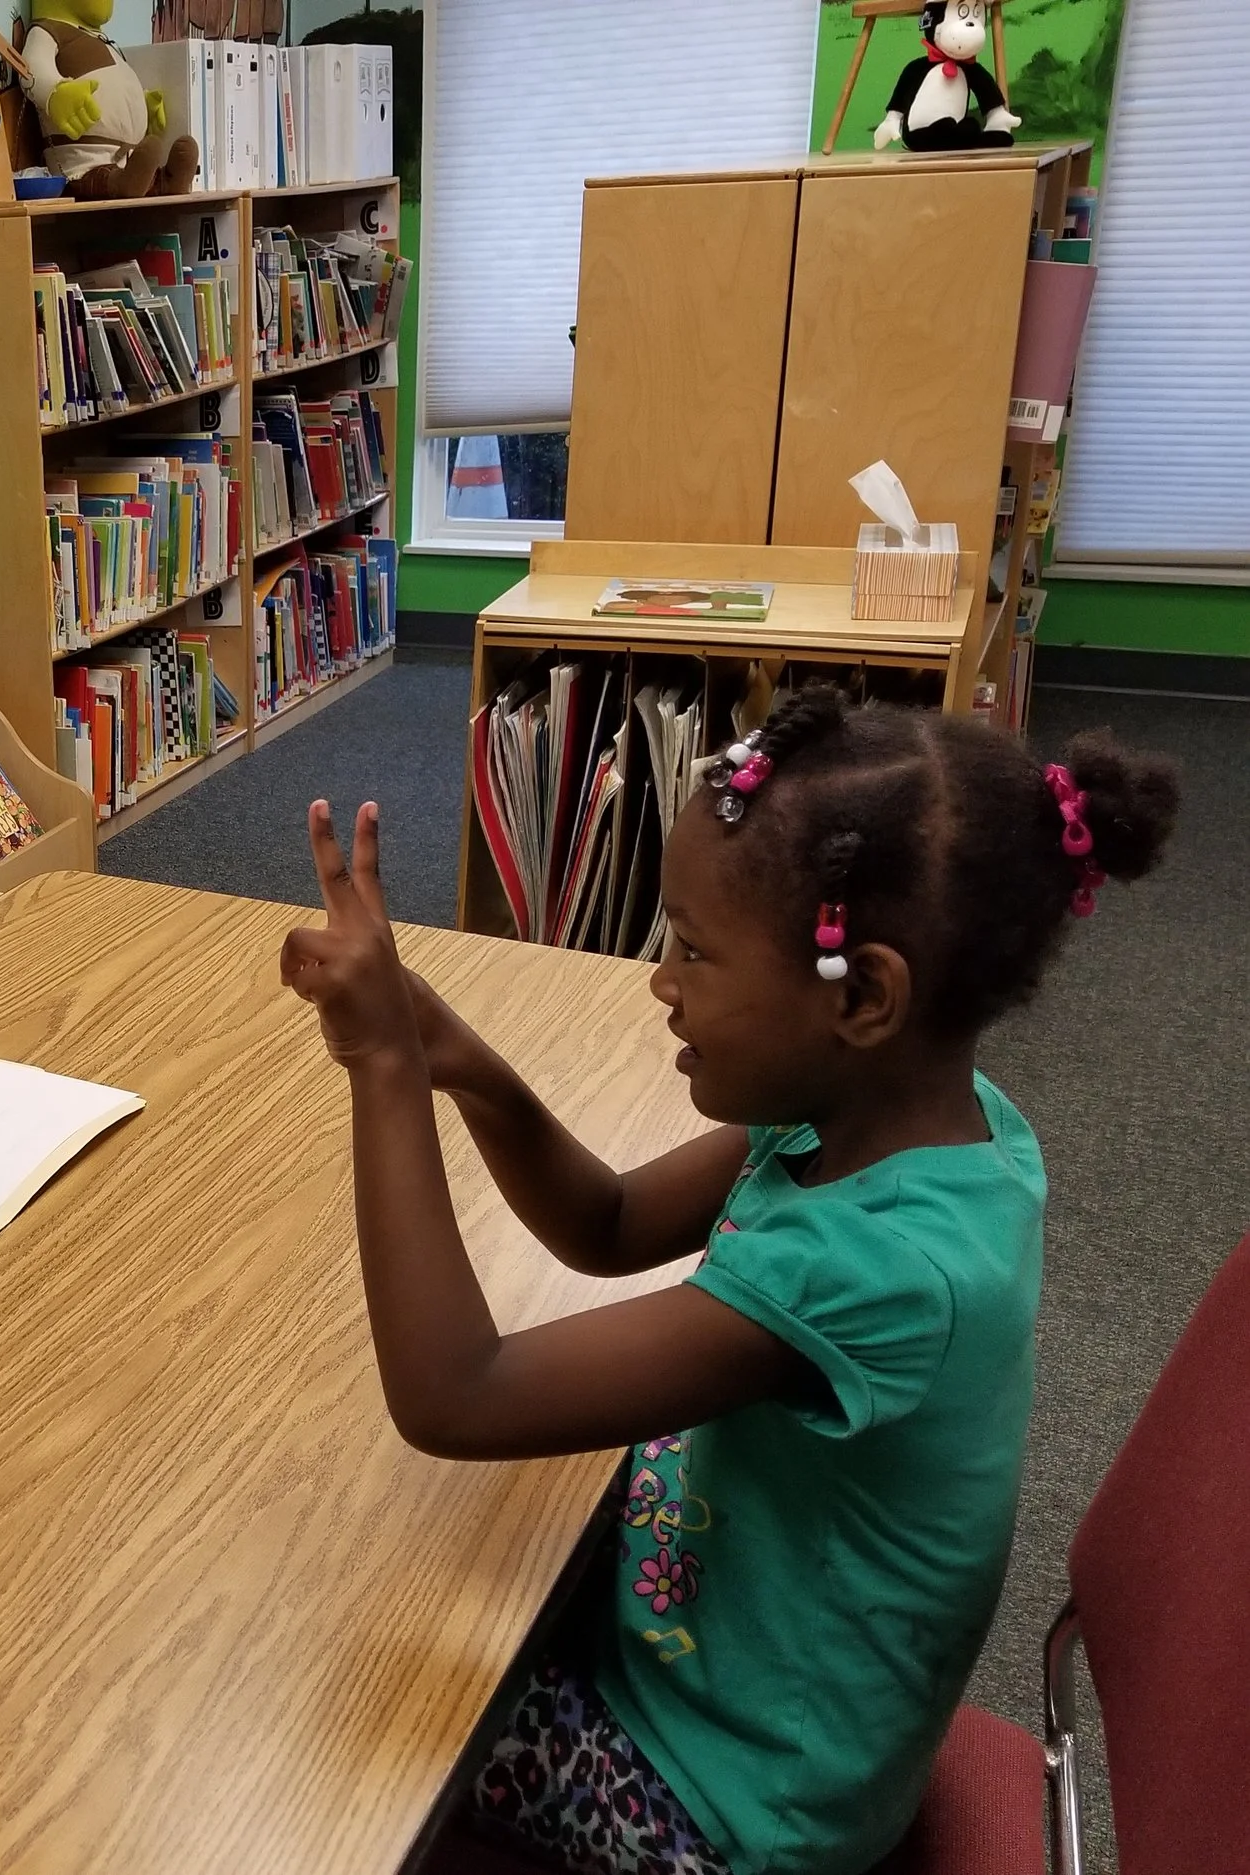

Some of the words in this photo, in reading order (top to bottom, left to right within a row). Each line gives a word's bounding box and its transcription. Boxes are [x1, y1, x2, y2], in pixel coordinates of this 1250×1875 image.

[361, 352, 380, 385] D
[200, 391, 222, 431] B
[203, 586, 223, 620] B
[623, 1467, 682, 1546] Be
